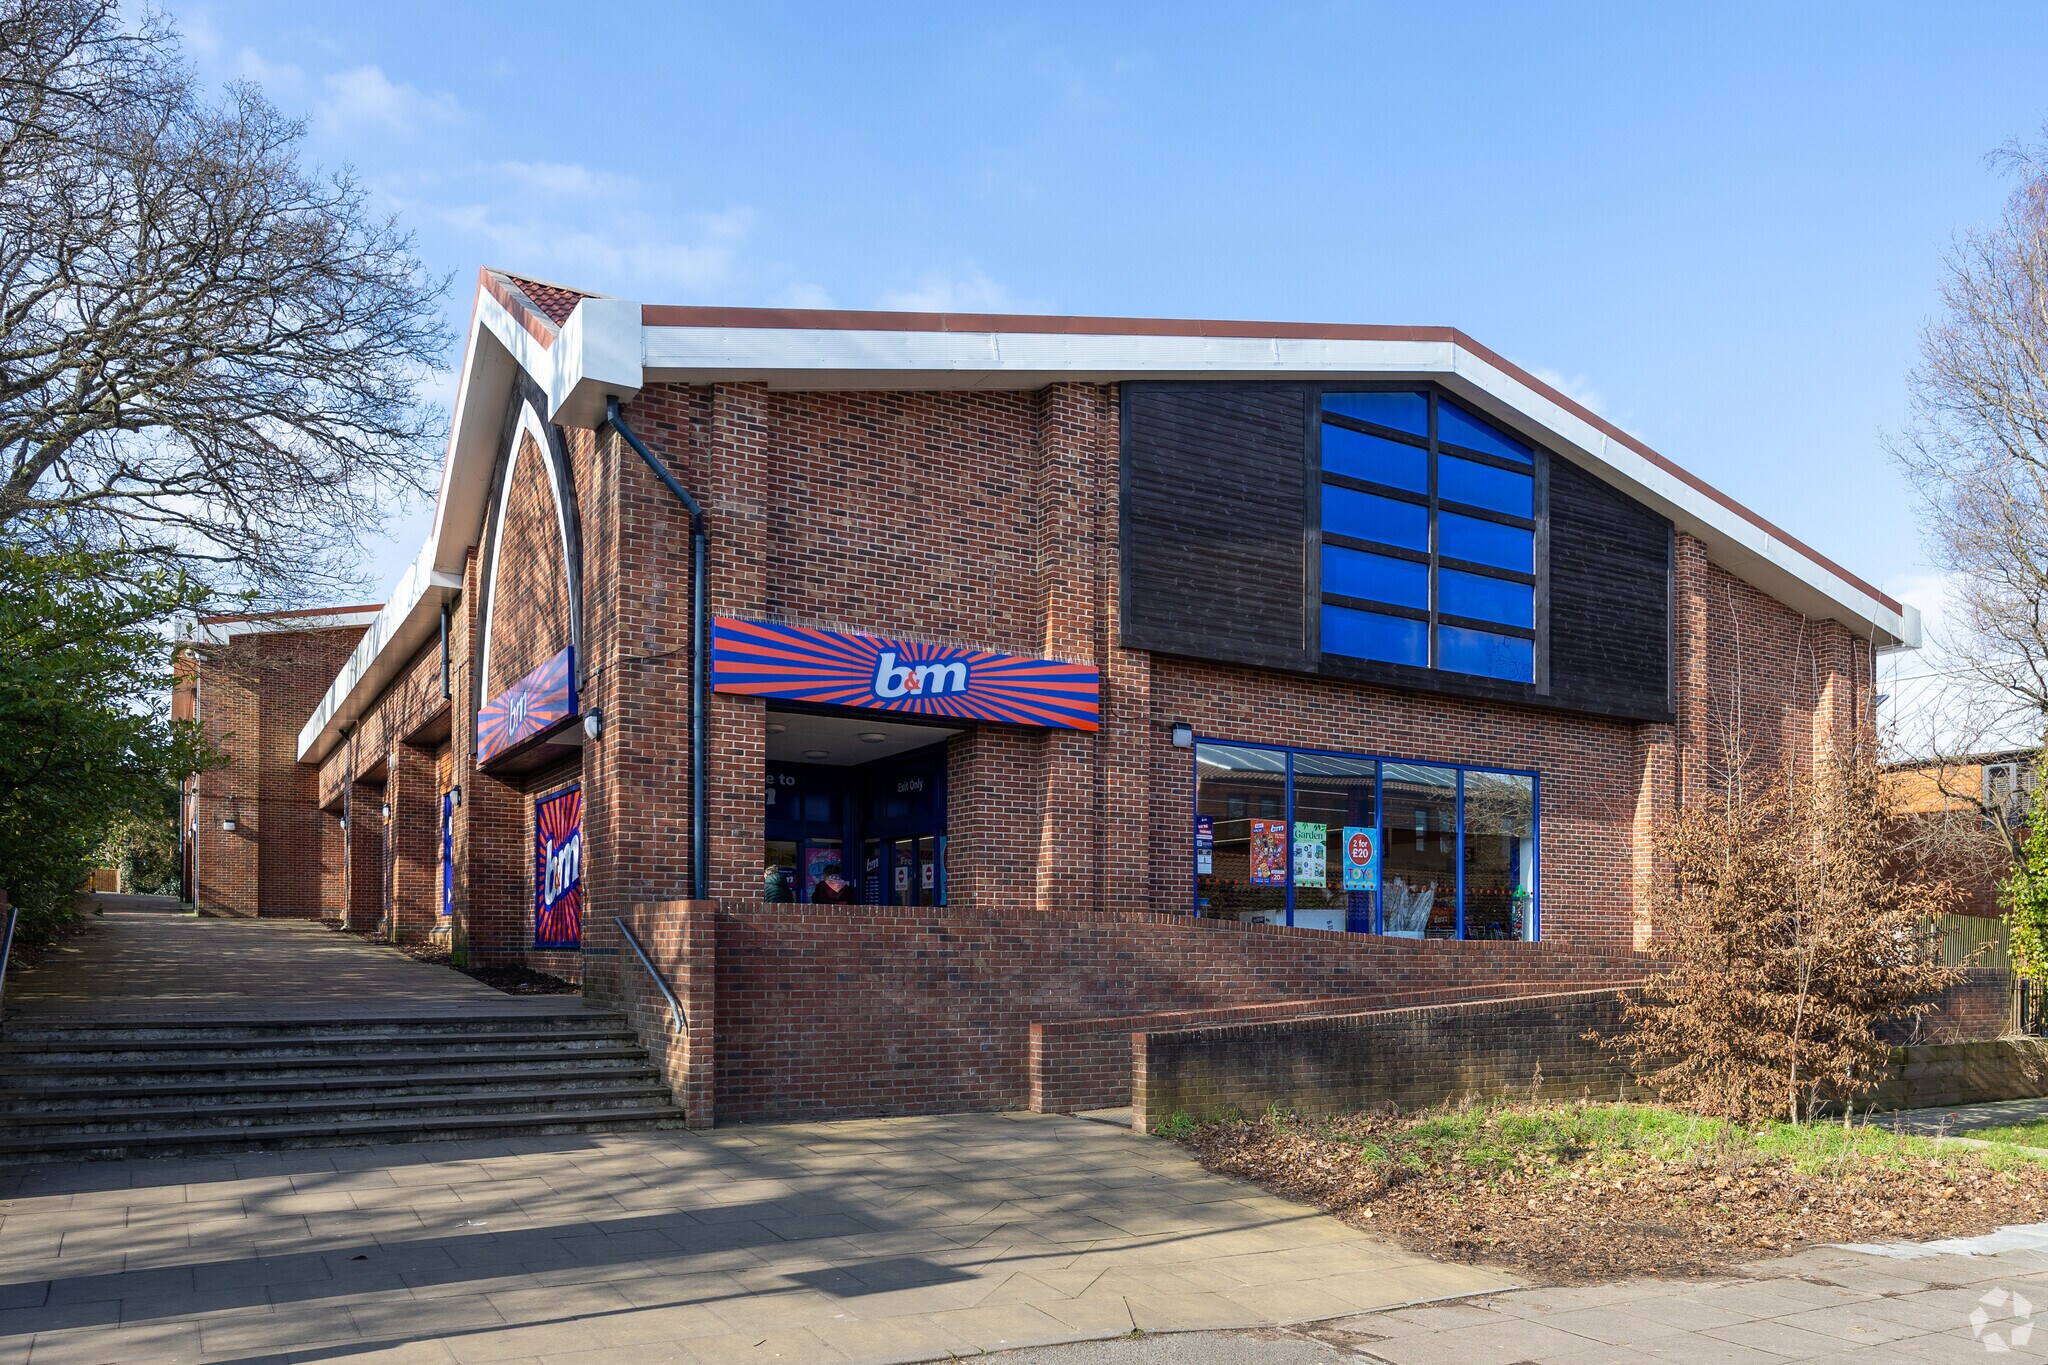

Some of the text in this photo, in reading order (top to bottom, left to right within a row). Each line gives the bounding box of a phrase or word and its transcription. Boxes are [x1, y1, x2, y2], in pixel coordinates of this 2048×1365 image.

[875, 652, 966, 698] b&m
[779, 773, 796, 786] to
[897, 778, 924, 793] Exit Only
[1294, 830, 1323, 840] Garden
[1358, 840, 1368, 848] for
[1352, 848, 1369, 859] £20
[545, 834, 579, 905] b&m
[1348, 867, 1373, 880] TOYS
